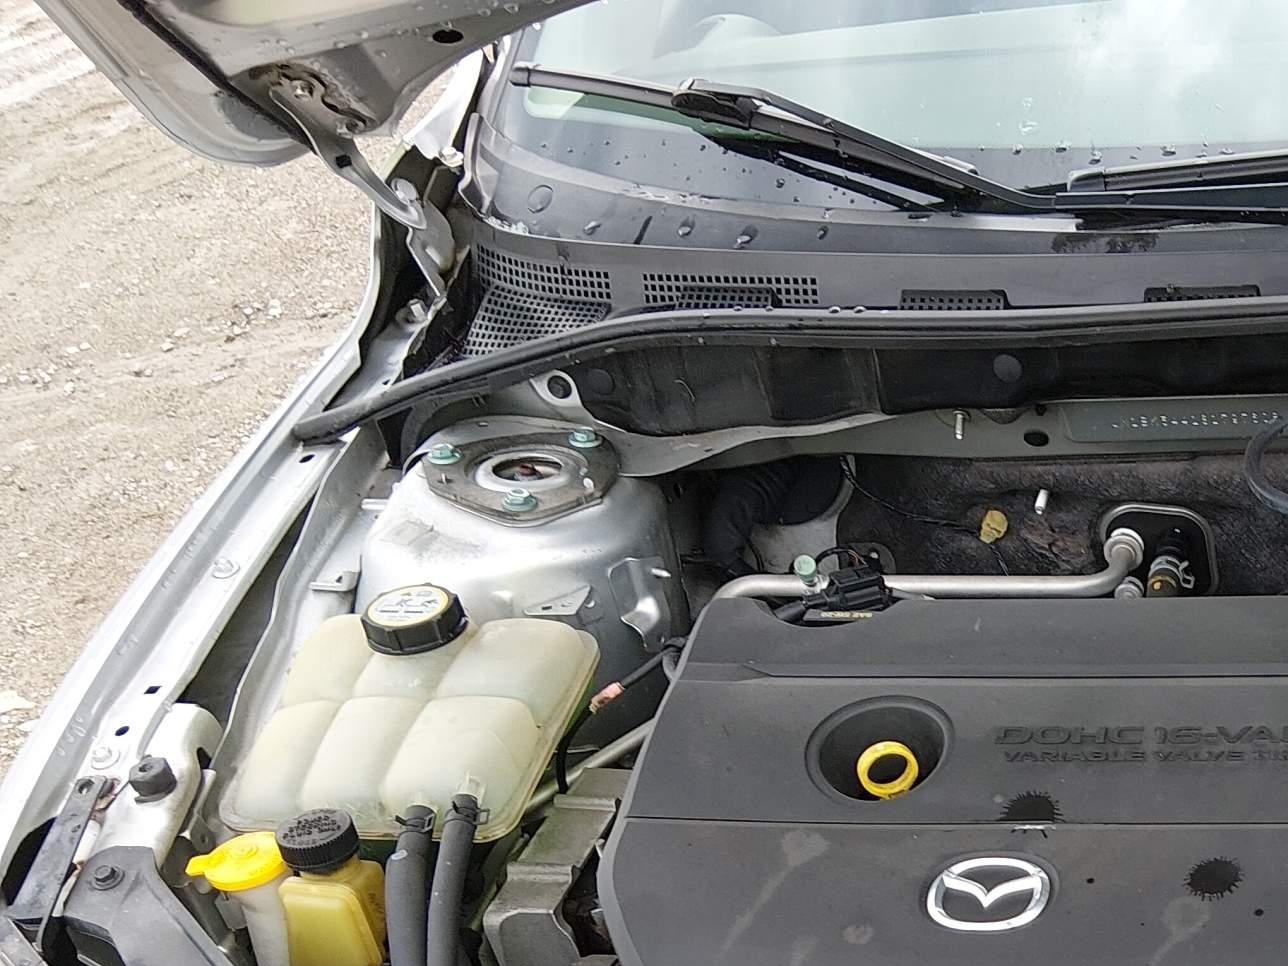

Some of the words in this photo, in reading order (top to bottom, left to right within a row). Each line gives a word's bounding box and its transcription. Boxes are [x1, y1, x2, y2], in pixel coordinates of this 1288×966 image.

[995, 724, 1145, 746] DOHC
[1003, 749, 1146, 763] VARIABLE
[1155, 749, 1245, 763] VALVE
